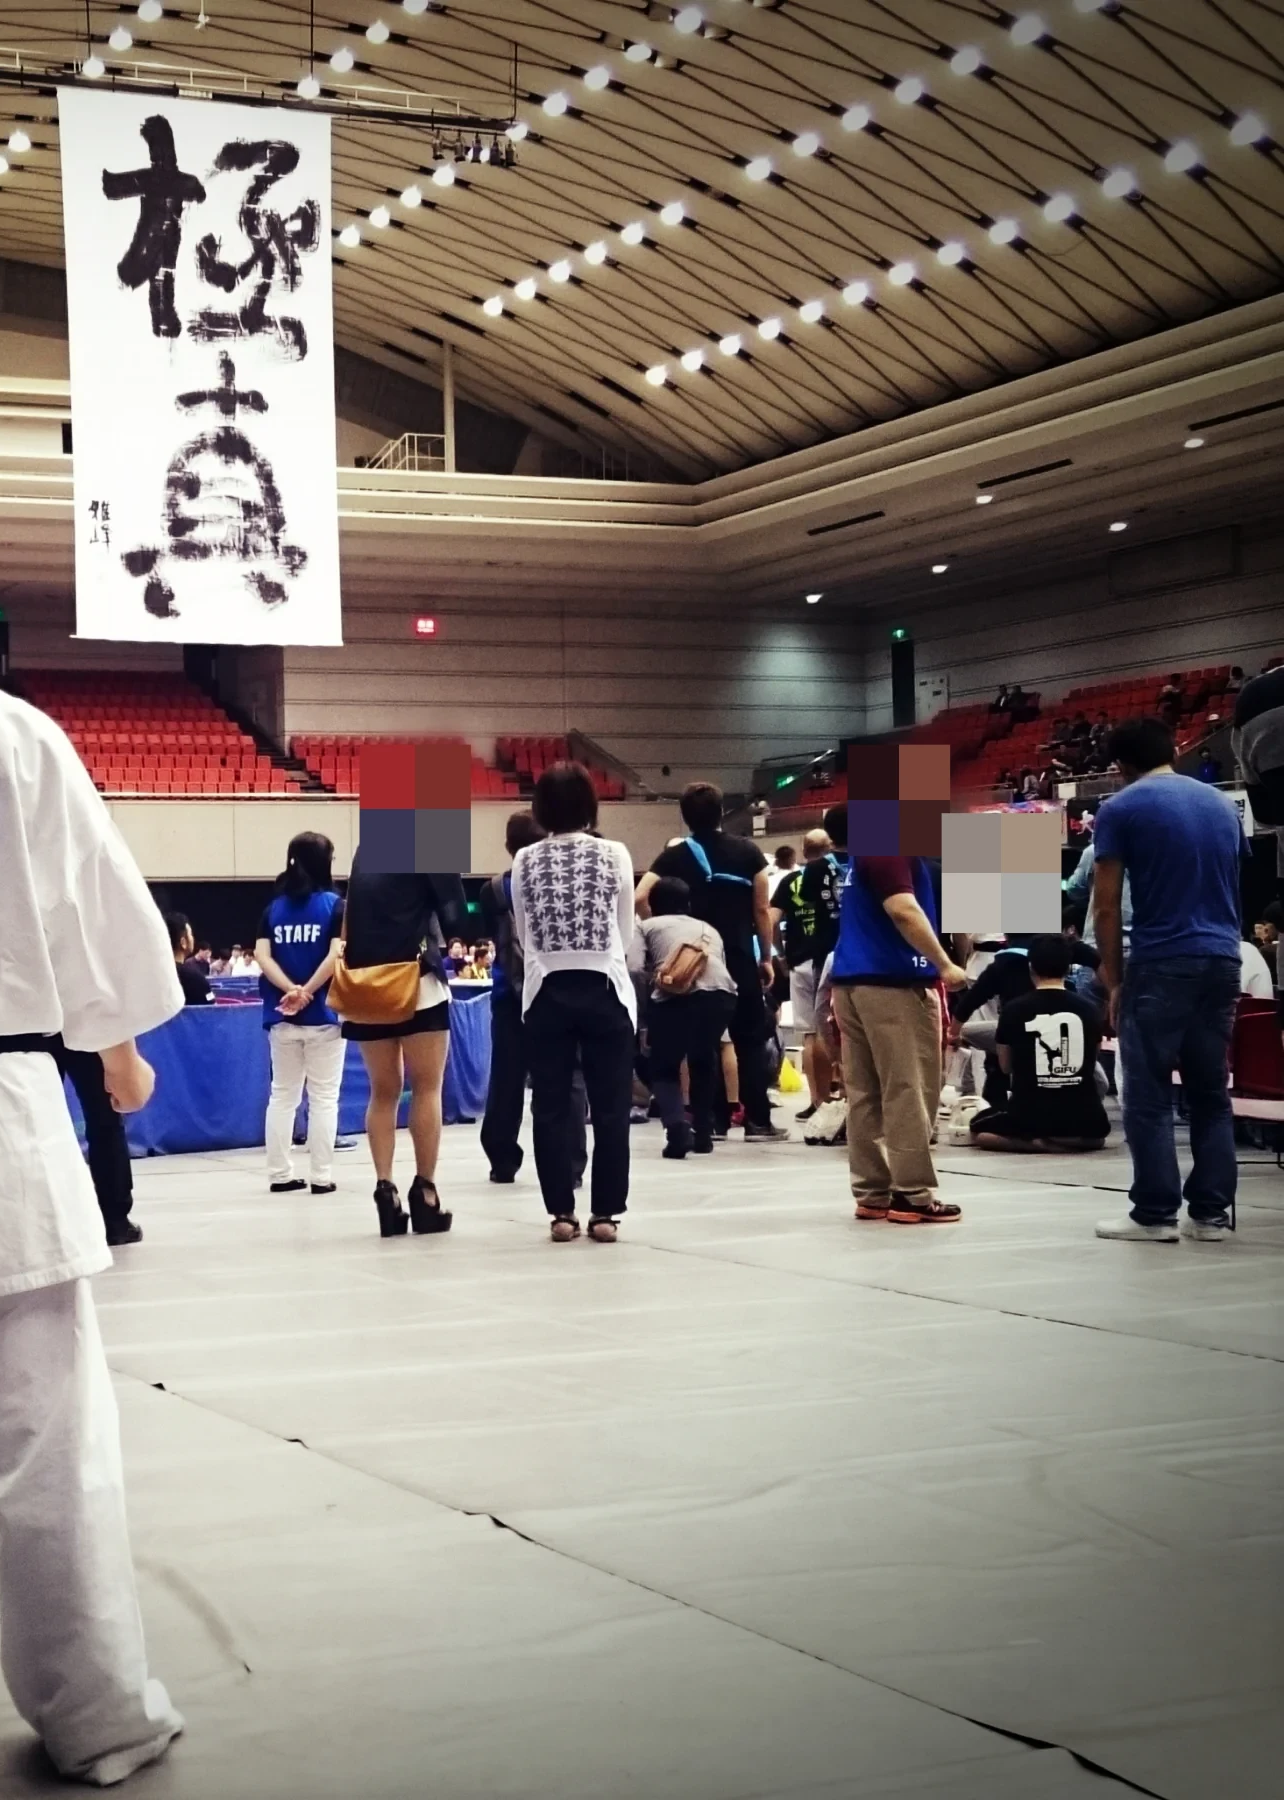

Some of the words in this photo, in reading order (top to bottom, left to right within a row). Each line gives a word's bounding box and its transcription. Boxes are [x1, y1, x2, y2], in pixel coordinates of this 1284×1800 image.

[274, 924, 321, 943] STAFF
[912, 956, 927, 967] 15
[1025, 1012, 1084, 1076] 10
